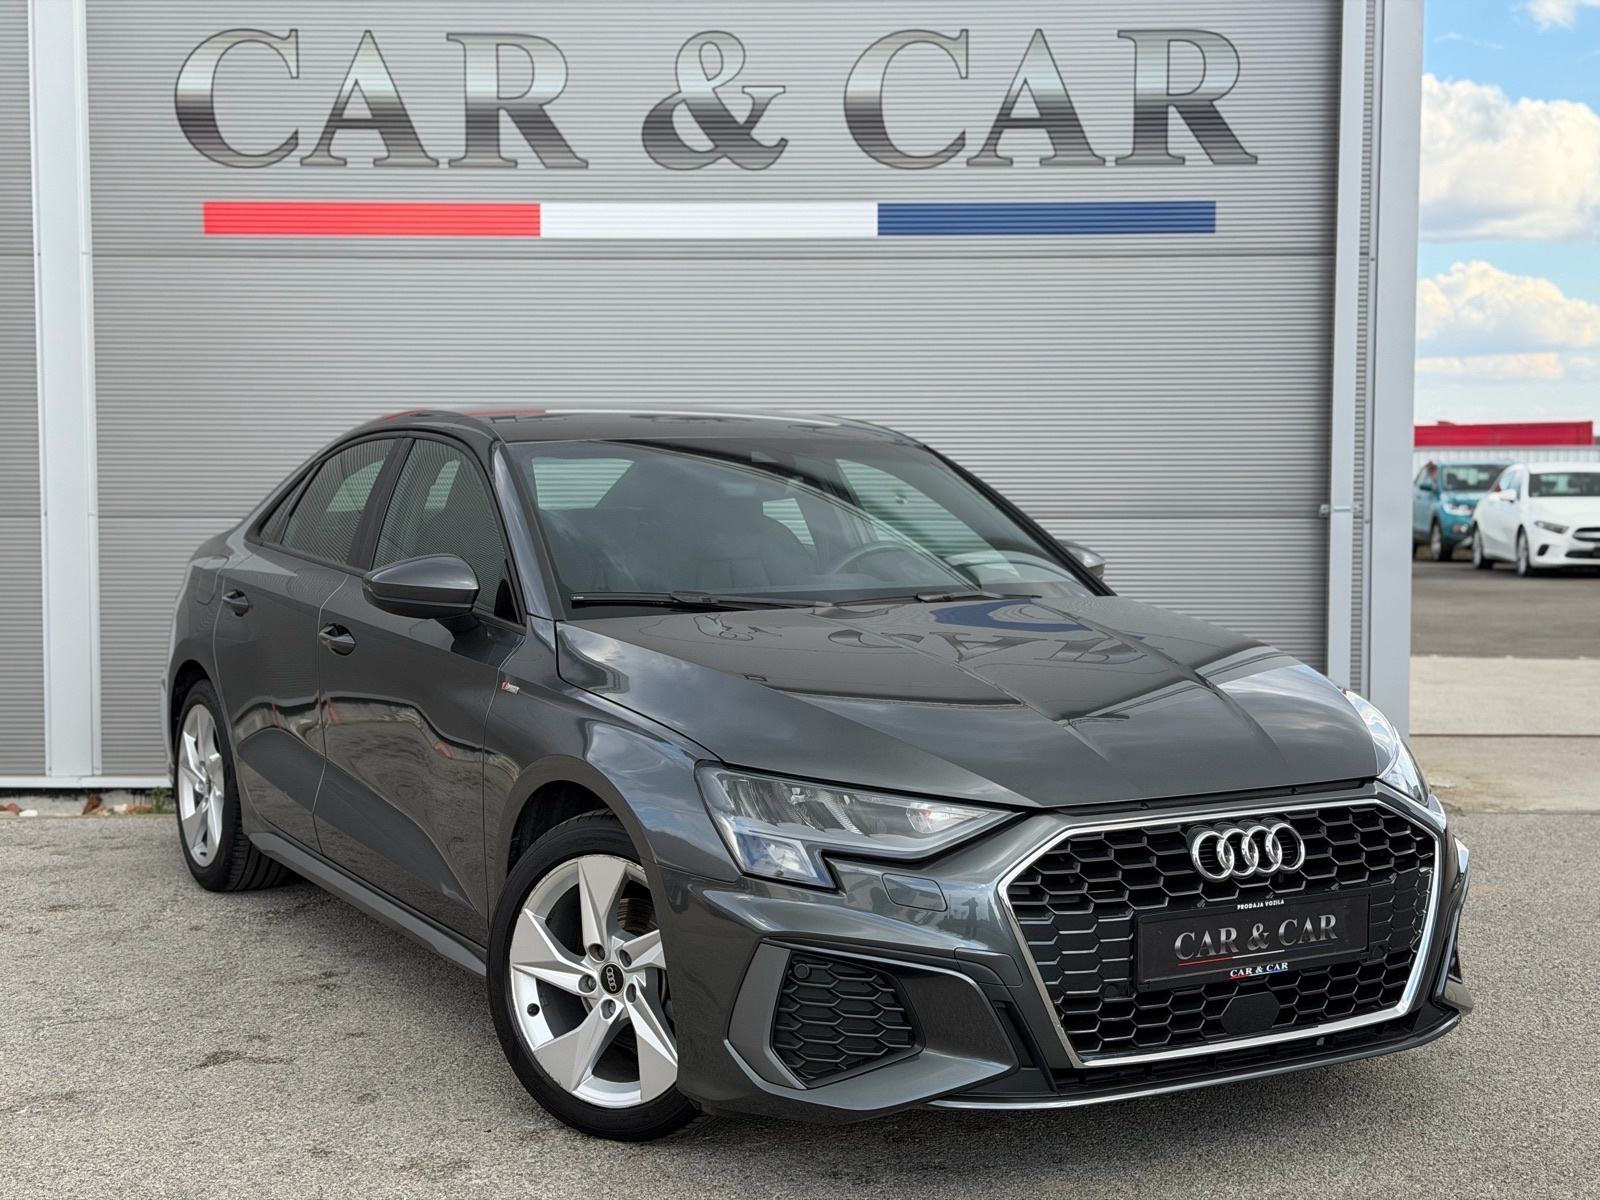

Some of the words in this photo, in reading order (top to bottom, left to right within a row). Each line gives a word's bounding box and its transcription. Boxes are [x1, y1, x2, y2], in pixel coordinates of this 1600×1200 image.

[174, 28, 589, 169] CAR
[641, 30, 788, 171] &
[843, 28, 1258, 170] CAR
[1237, 902, 1264, 910] PRODAJA
[1265, 899, 1284, 907] VOZILA
[1174, 927, 1239, 960] CAR
[1247, 923, 1270, 950] &
[1278, 914, 1338, 946] CAR
[1230, 967, 1252, 977] CAR
[1255, 965, 1263, 973] &
[1266, 962, 1288, 971] CAR
